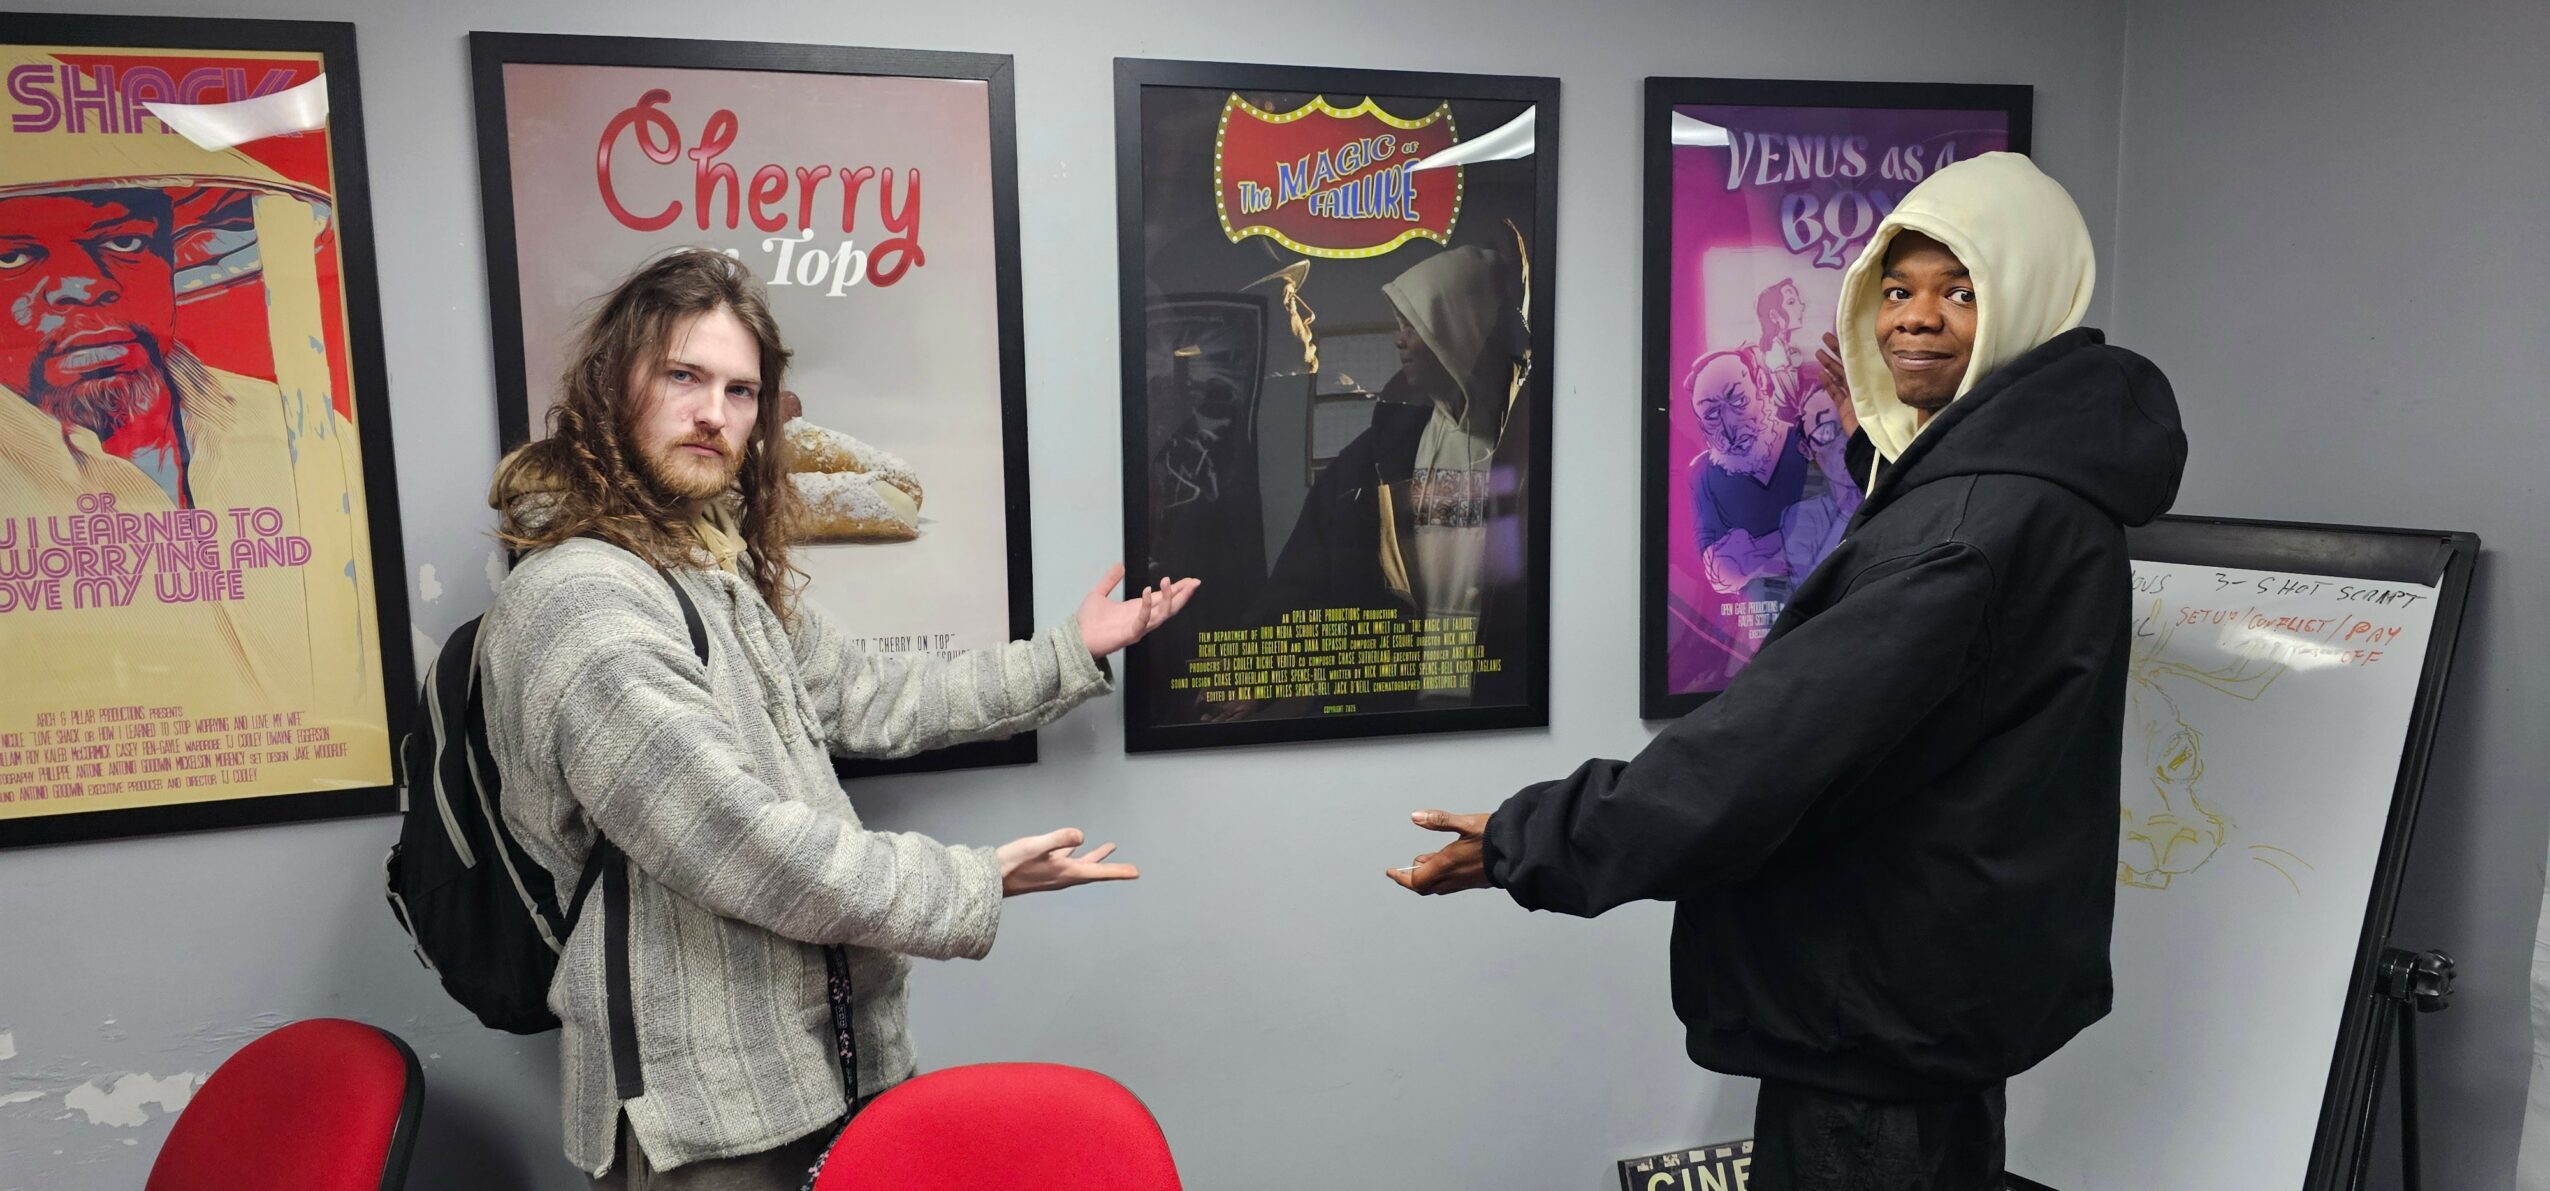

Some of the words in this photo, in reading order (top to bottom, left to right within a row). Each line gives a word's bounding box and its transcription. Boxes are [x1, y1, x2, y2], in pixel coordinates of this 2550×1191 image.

[1238, 181, 1272, 215] The
[1276, 134, 1396, 210] MAGIC
[1725, 130, 1867, 190] VENUS
[597, 88, 926, 288] Cherry
[1308, 159, 1420, 222] FAILURE
[762, 228, 868, 298] Top
[77, 492, 118, 513] OR
[28, 517, 38, 548] I
[48, 509, 218, 546] LEARNED
[228, 507, 283, 539] TO
[0, 540, 220, 580] WORRYING
[230, 536, 312, 569] AND
[0, 580, 62, 613] OVE
[73, 574, 142, 609] MY
[154, 570, 246, 603] WIFE
[1749, 600, 1778, 613] PRODUCTIONS
[1292, 610, 1306, 623] OPEN
[1309, 609, 1321, 622] GATE
[1325, 608, 1360, 621] PRODUCTIONS
[1363, 609, 1398, 620] PRODUCTIONS
[918, 635, 928, 650] ON
[1214, 630, 1248, 641] DEPARTMENT
[1322, 623, 1347, 636] PRESENTS
[37, 712, 55, 727] ARCH
[71, 709, 95, 725] PILLAR
[100, 706, 145, 722] PRODUCTIONS
[150, 706, 183, 719] PRESENTS
[56, 729, 80, 744] SHACK
[98, 726, 114, 741] HOW
[126, 723, 156, 739] LEARNED
[160, 722, 169, 736] TO
[173, 720, 191, 735] STOP
[195, 717, 229, 733] WORRYING
[234, 716, 248, 730] AND
[252, 714, 269, 729] LOVE
[273, 713, 282, 727] MY
[116, 742, 138, 758] CASEY
[185, 739, 221, 752] WARDROBE
[238, 732, 262, 748] COOLEY
[267, 730, 292, 745] DWAYNE
[141, 758, 171, 774] GOODWIN
[250, 753, 261, 764] SET
[267, 751, 288, 763] DESIGN
[293, 746, 310, 760] JAKE
[53, 783, 84, 799] GOODWIN
[88, 782, 124, 795] EXECUTIVE
[128, 779, 162, 792] PRODUCER
[167, 777, 181, 789] AND
[186, 774, 216, 787] DIRECTOR
[233, 768, 257, 783] COOLEY
